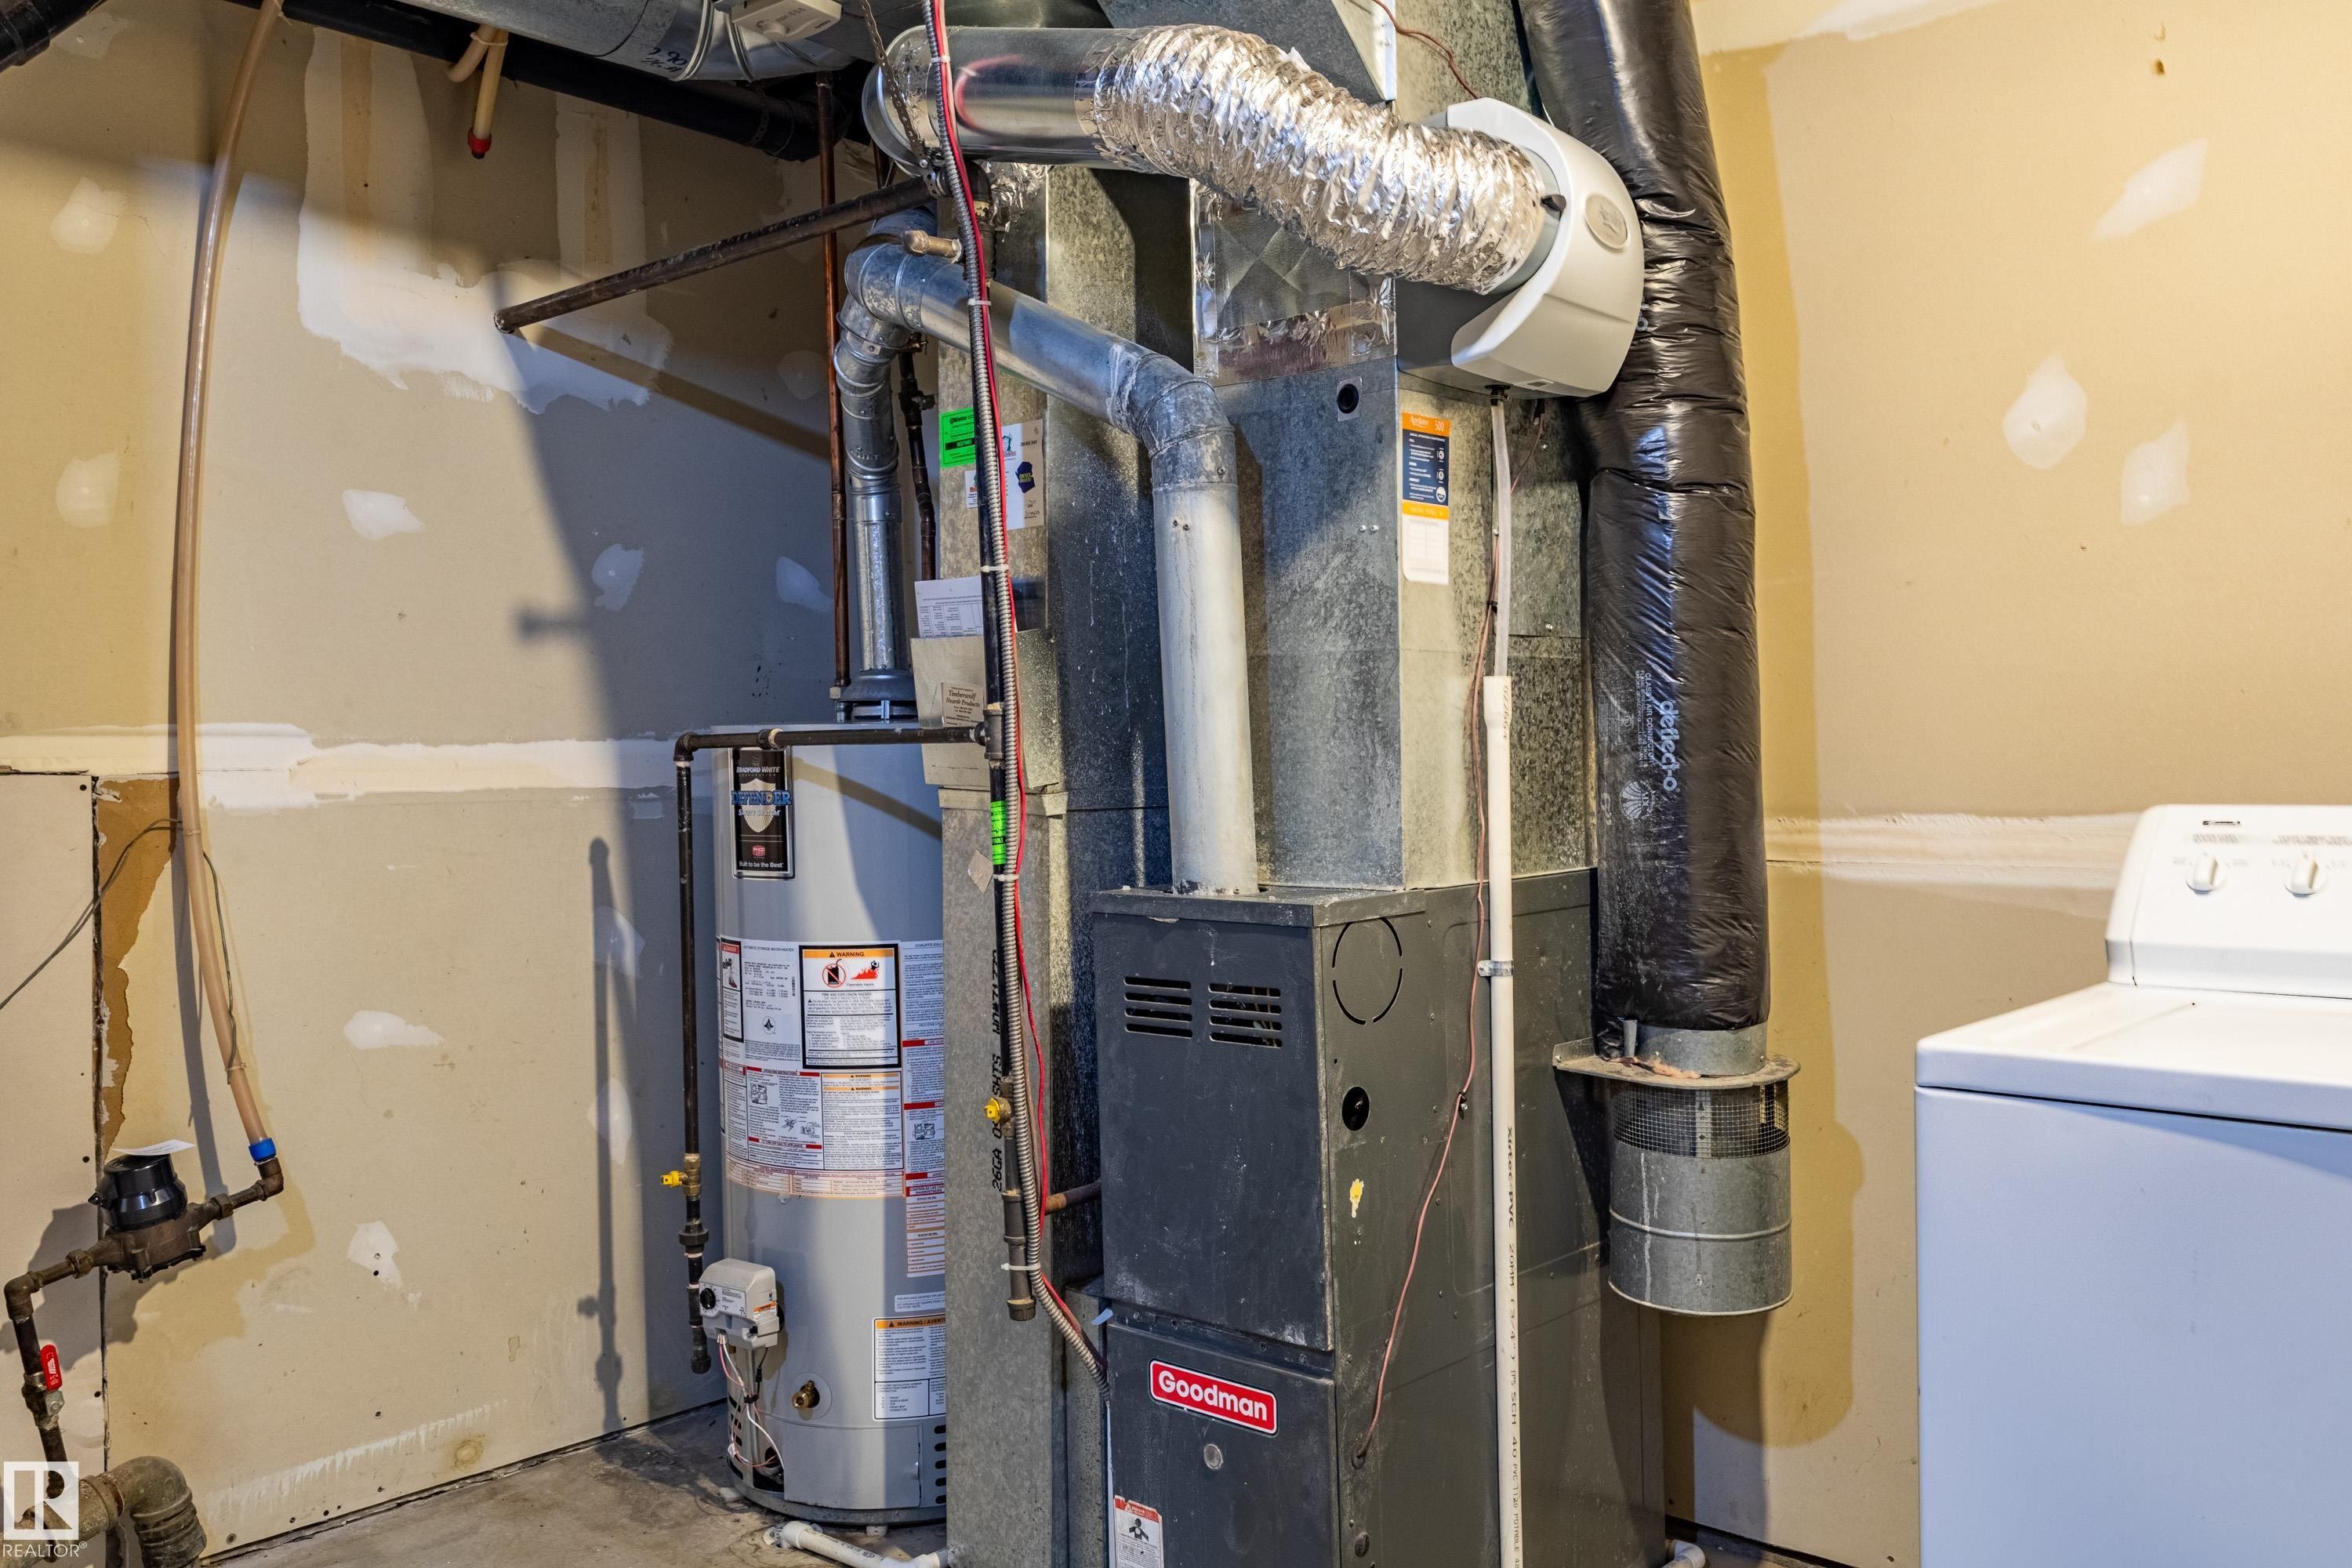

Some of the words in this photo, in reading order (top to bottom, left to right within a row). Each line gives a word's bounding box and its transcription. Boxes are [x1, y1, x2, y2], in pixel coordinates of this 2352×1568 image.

[1436, 420, 1444, 431] 500
[949, 690, 976, 701] Timberwolf
[731, 790, 791, 805] DEFENDER
[992, 1148, 1002, 1192] 26GA
[1159, 1370, 1267, 1421] Goodman
[1512, 1436, 1518, 1458] 40
